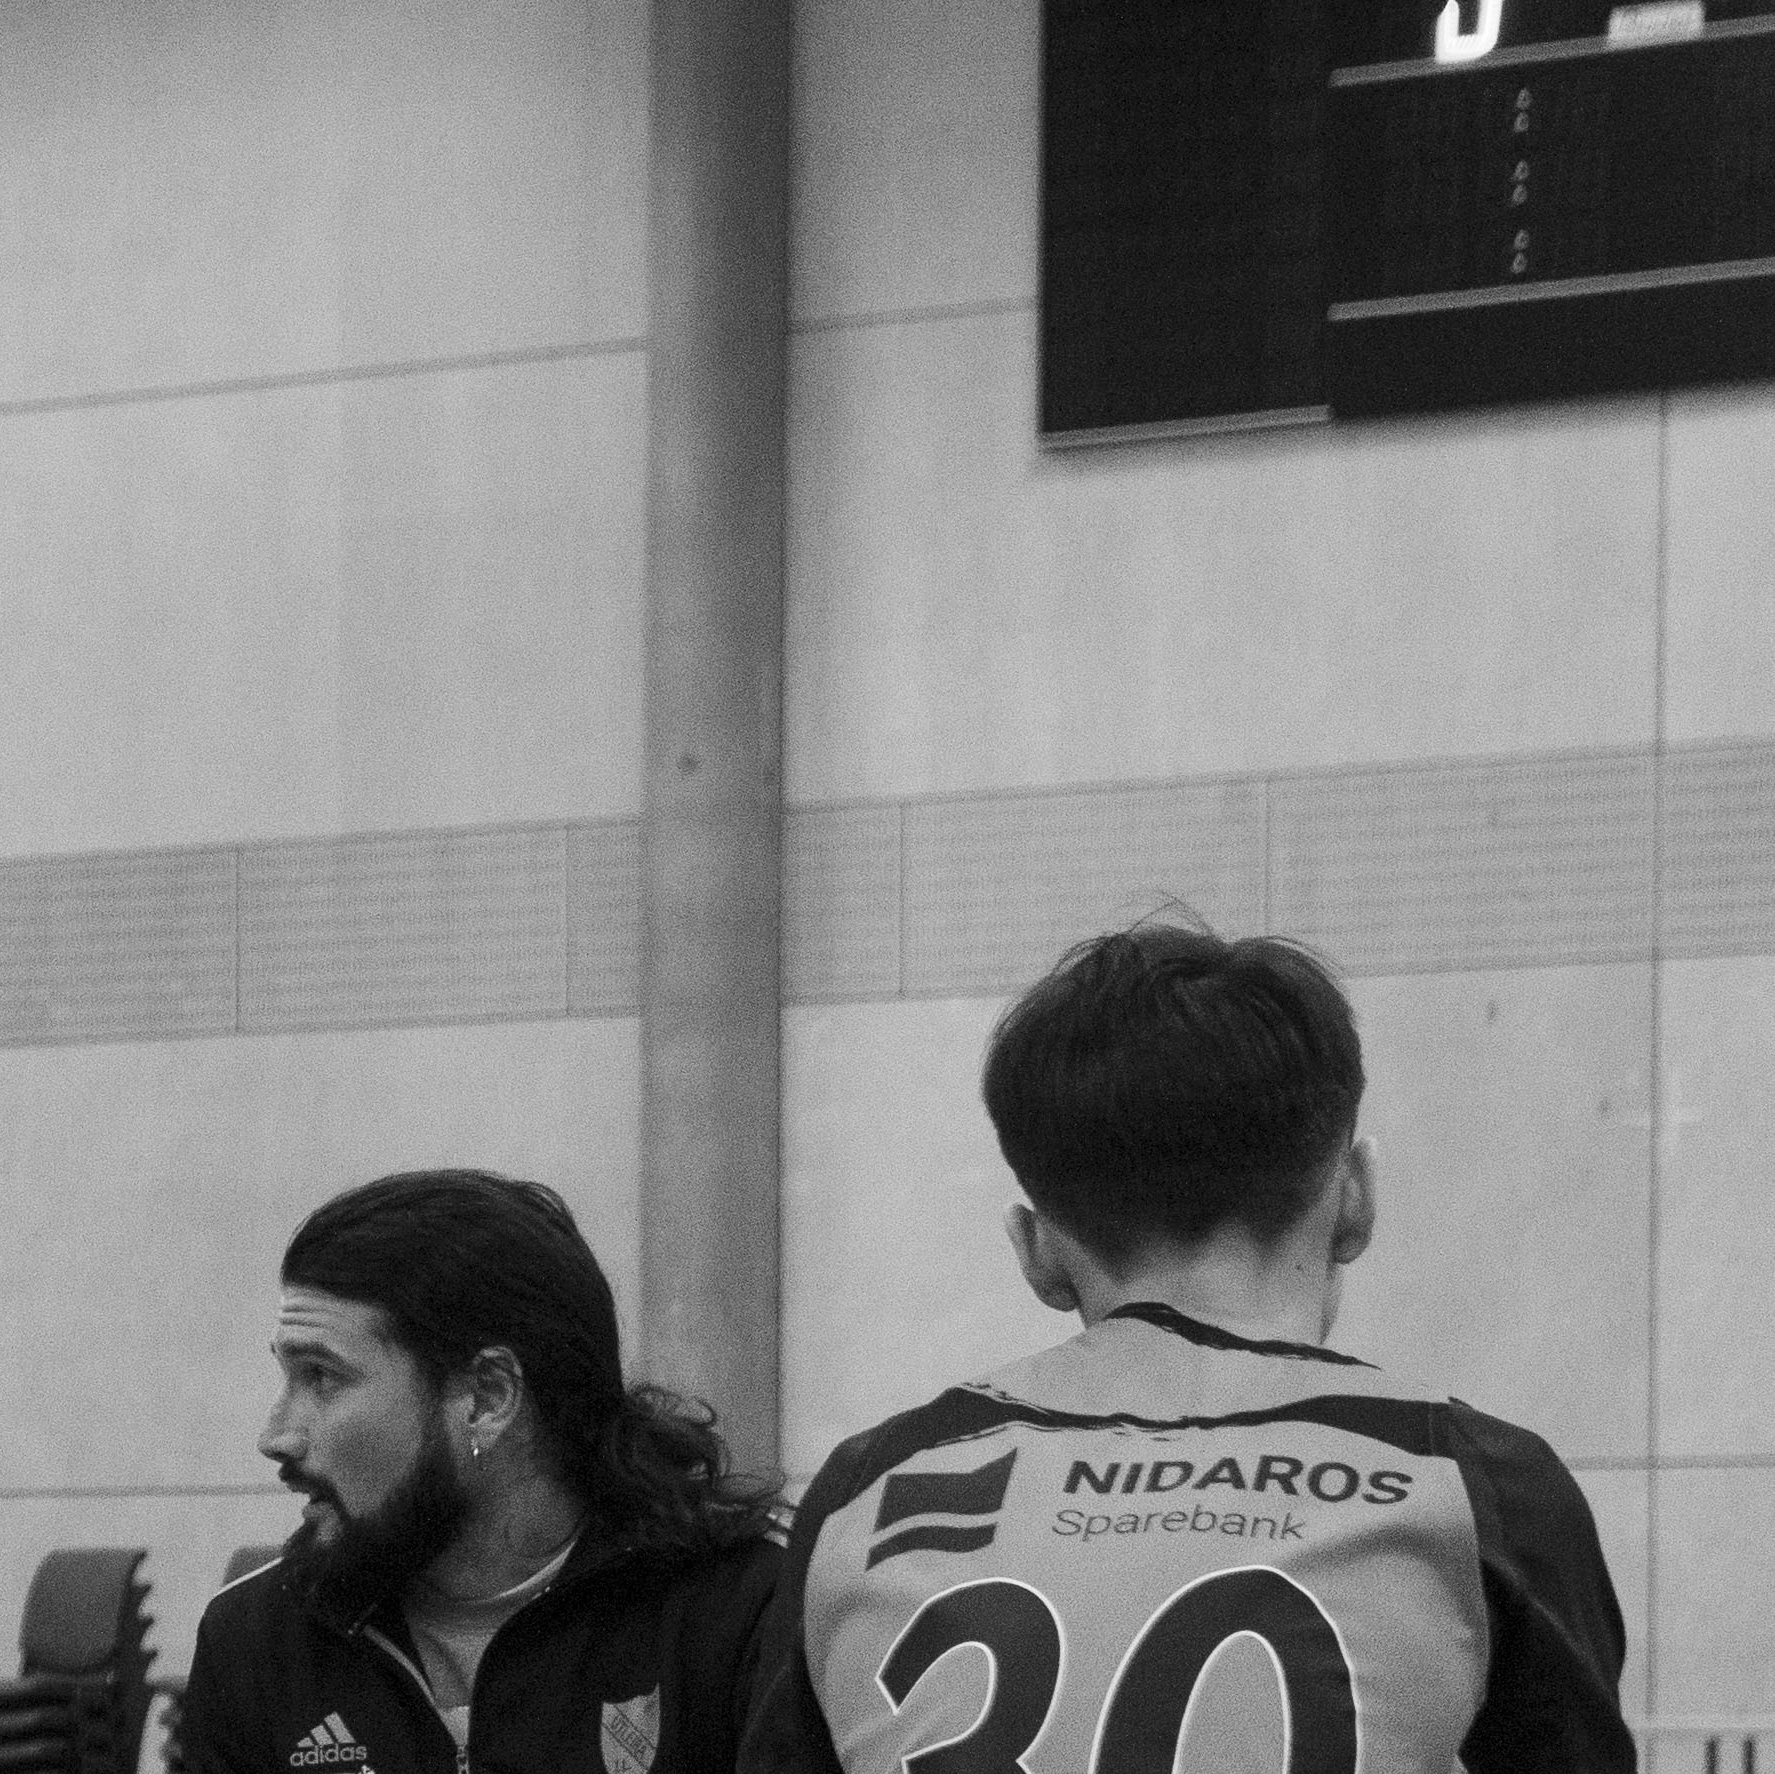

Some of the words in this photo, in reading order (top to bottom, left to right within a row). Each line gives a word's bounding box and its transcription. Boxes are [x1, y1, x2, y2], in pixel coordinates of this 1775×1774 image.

[1063, 1455, 1416, 1504] NIDAROS
[1051, 1501, 1308, 1542] Sparebank
[289, 1743, 368, 1767] adidas
